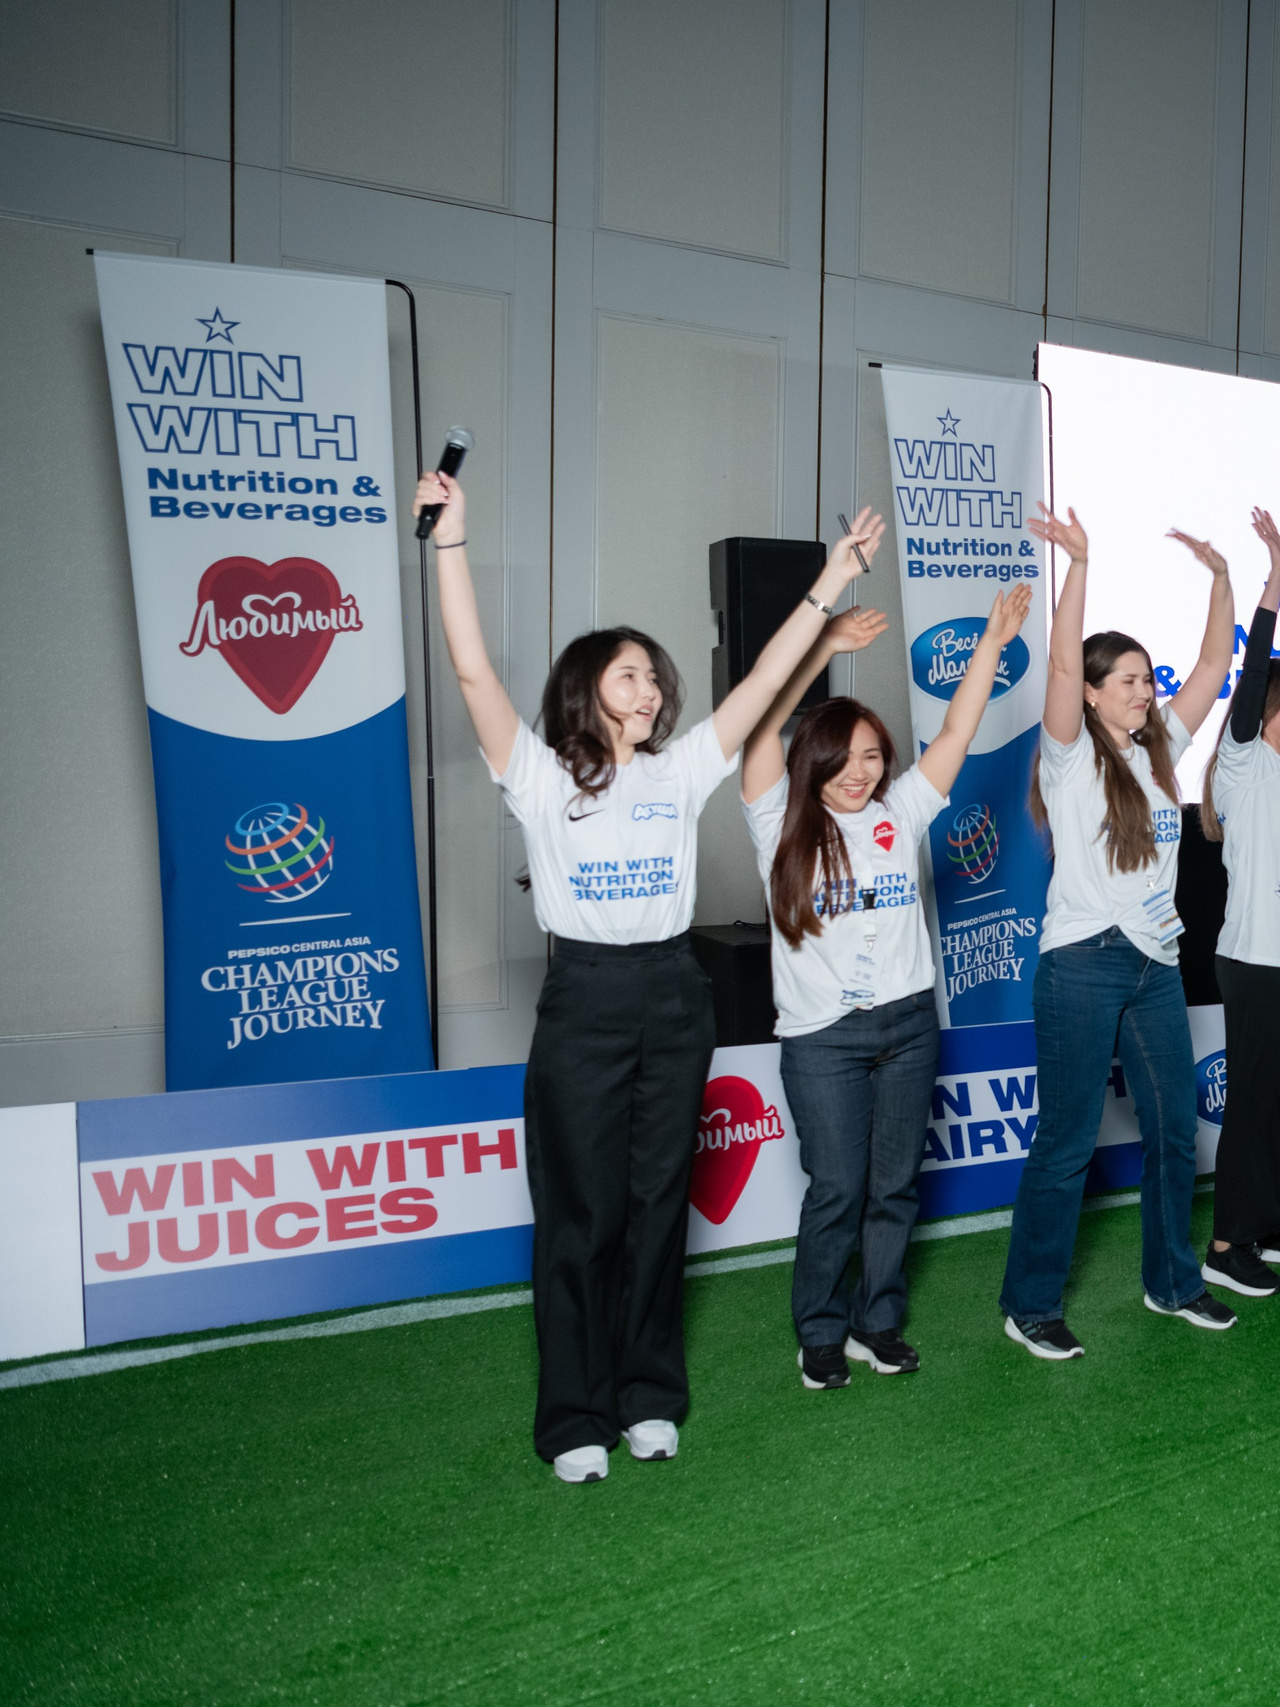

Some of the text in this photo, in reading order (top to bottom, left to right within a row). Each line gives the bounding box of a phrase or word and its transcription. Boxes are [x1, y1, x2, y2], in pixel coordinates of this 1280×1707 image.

[122, 343, 303, 402] WIN
[126, 403, 358, 461] WITH
[894, 438, 996, 483] WIN
[147, 468, 383, 497] Nutrition &
[149, 496, 388, 527] Beverages
[896, 486, 1022, 529] WITH
[906, 537, 1036, 557] Nutrition &
[908, 560, 1040, 582] Beverages
[183, 591, 360, 654] Любимый
[932, 628, 1007, 657] Весё
[1154, 665, 1182, 697] &
[1153, 809, 1177, 820] ITH
[569, 870, 673, 887] NUTRITION
[578, 856, 673, 873] WIN WITH
[874, 872, 908, 886] ITH
[947, 907, 1017, 931] PEPSICO CENTRAL ASIA
[228, 936, 371, 959] PEPSICO CENTRAL ASIA
[952, 939, 1015, 975] LEAGUE
[201, 948, 400, 992] CHAMPIONS
[947, 958, 1025, 1003] JOURNEY
[238, 976, 371, 1014] LEAGUE
[227, 999, 386, 1050] JOURNEY
[695, 1107, 783, 1154] имый
[923, 1114, 1040, 1162] AIRY
[92, 1128, 518, 1216] WIN WITH
[95, 1187, 438, 1272] JUICES
